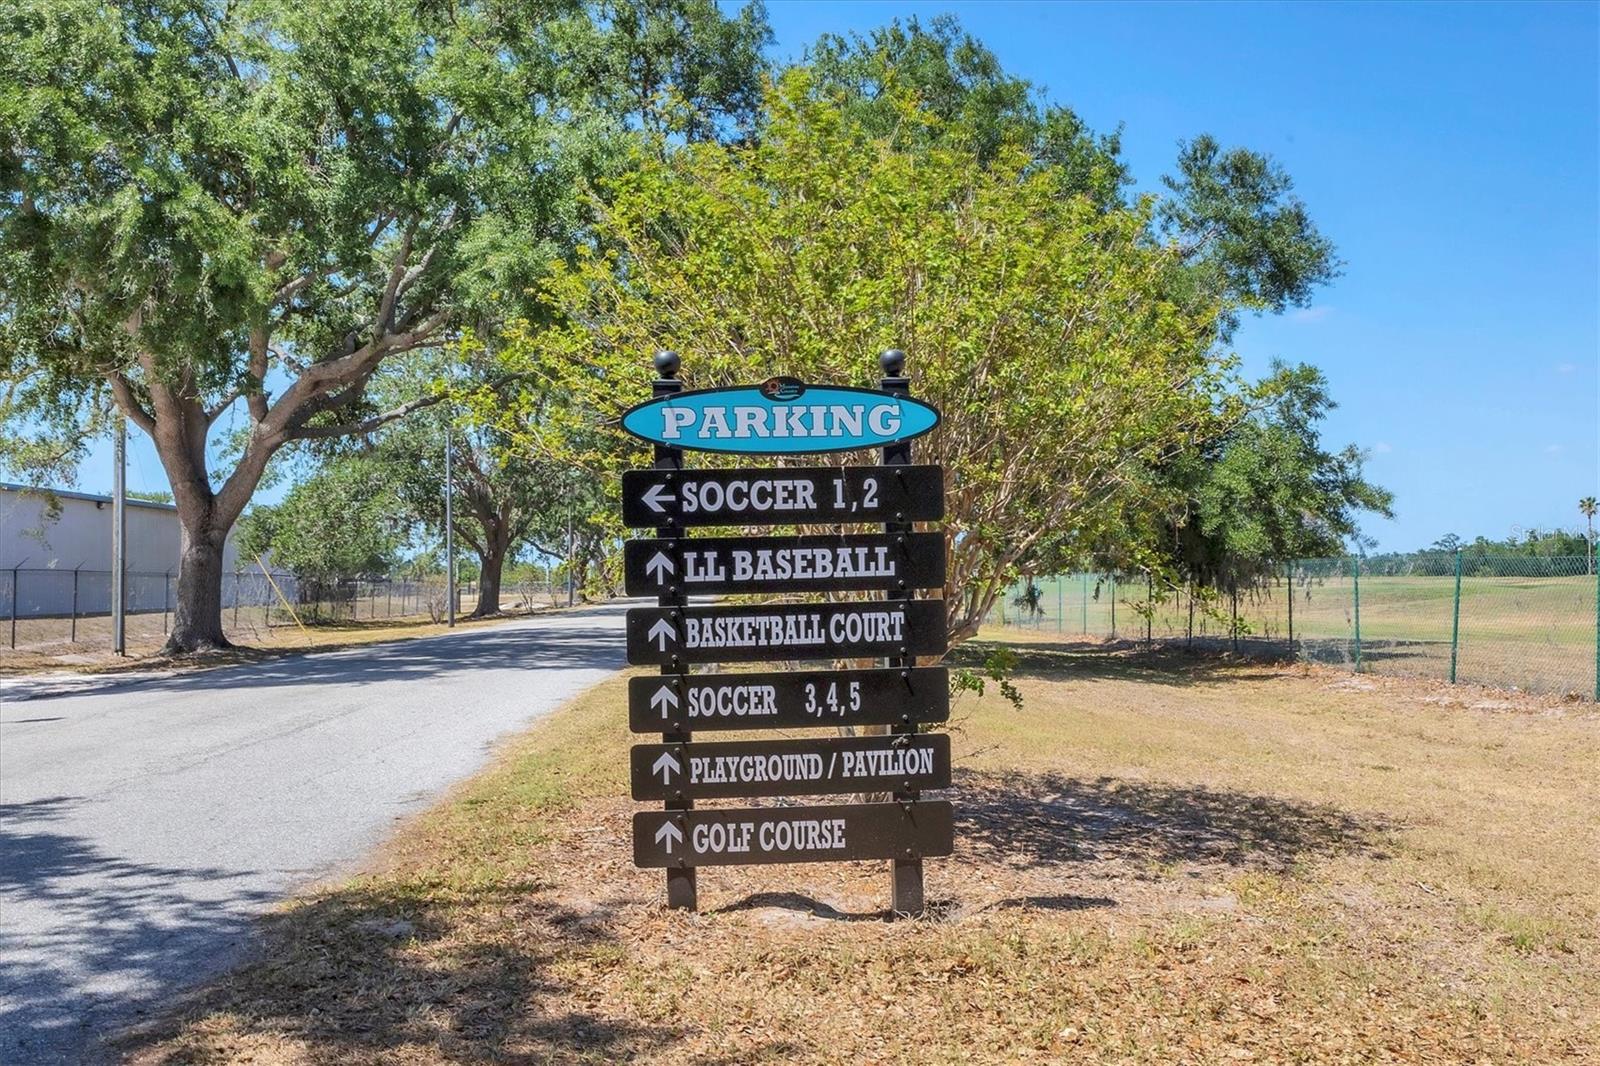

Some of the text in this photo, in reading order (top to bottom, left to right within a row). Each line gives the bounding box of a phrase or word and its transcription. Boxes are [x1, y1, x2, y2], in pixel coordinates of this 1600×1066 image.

[661, 404, 902, 439] PARKING
[682, 479, 817, 513] SOCCER
[683, 546, 895, 582] LL BASEBALL
[686, 611, 905, 648] BASKETBALL COURT
[688, 685, 778, 717] SOCCER
[690, 748, 934, 784] PLAYGROUND / PAVILION
[692, 819, 846, 854] GOLF COURSE
